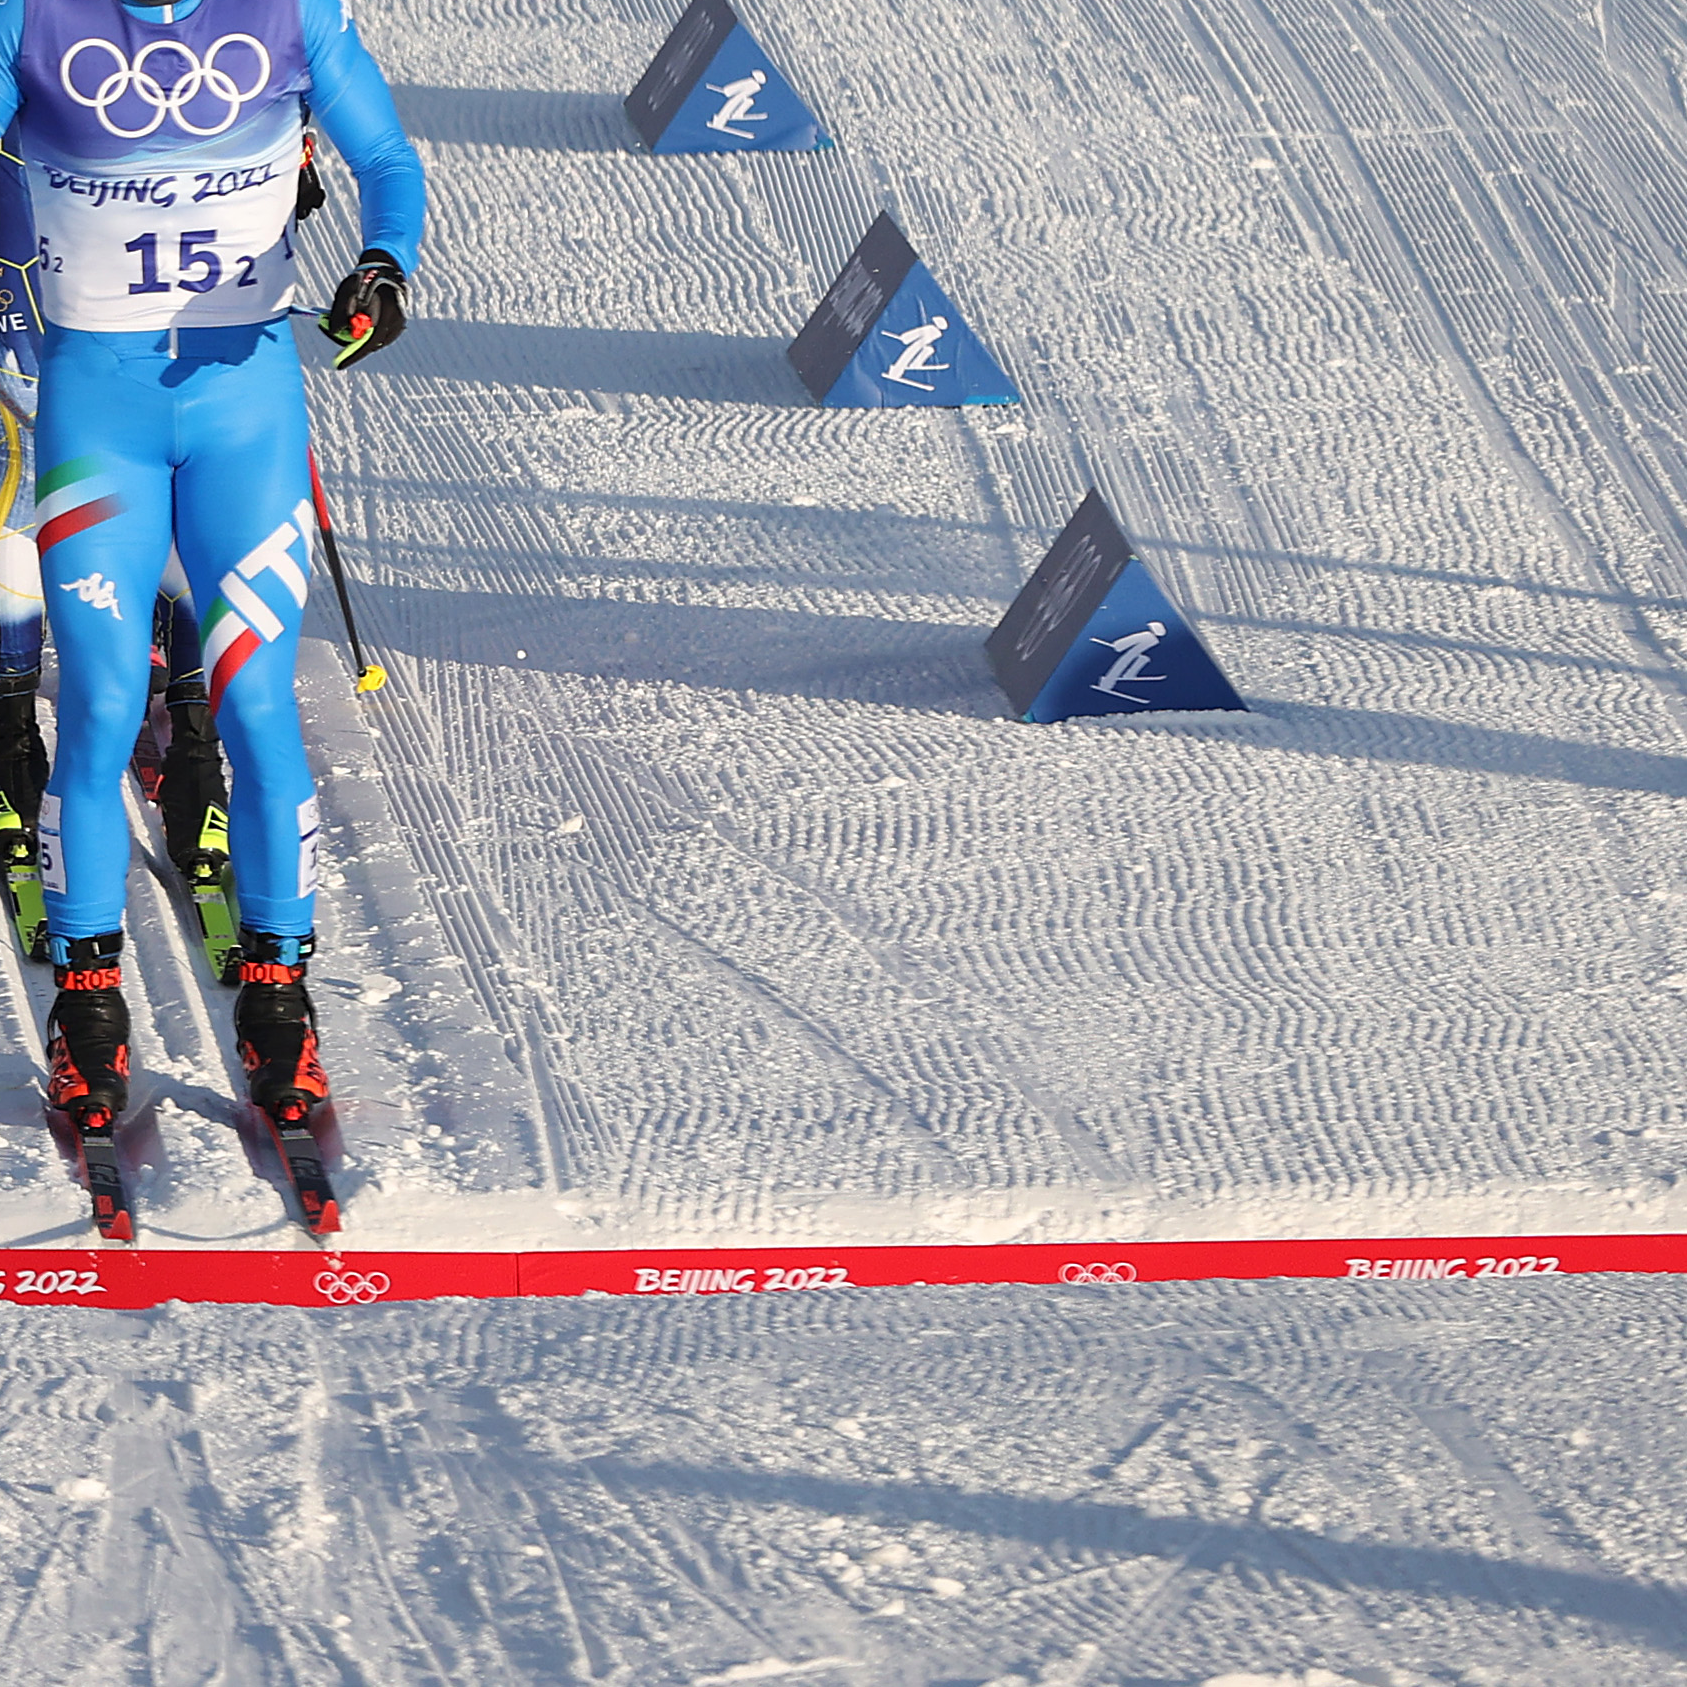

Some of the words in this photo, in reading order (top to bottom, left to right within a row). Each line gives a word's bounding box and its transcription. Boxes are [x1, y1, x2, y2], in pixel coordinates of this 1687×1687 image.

[43, 164, 178, 208] BEIJING
[124, 228, 224, 295] 15
[13, 1270, 108, 1295] 2022
[634, 1268, 756, 1294] BEIJING
[762, 1266, 857, 1291] 2022
